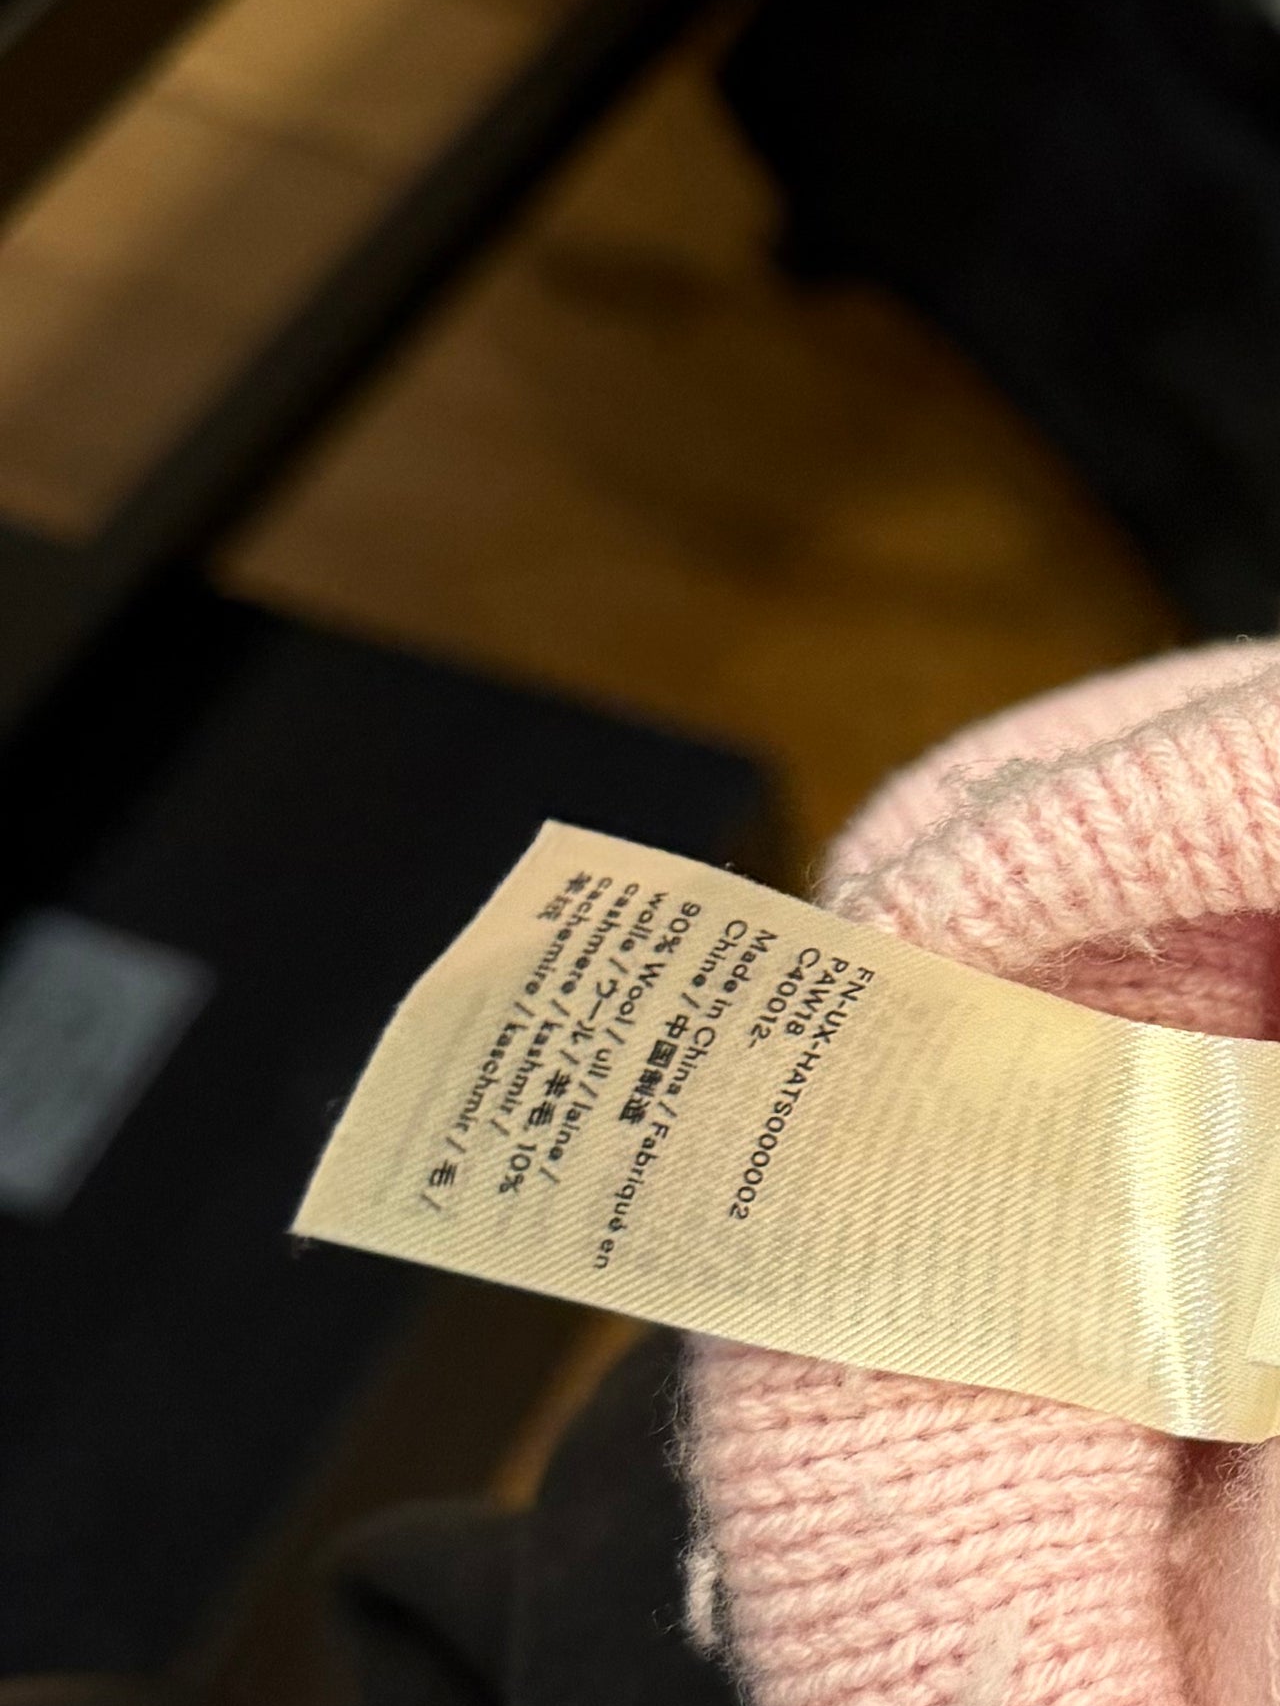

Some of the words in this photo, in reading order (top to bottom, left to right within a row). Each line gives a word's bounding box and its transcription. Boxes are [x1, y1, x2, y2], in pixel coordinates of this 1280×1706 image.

[523, 877, 612, 996] cachemire
[559, 883, 639, 995] cashmere
[619, 892, 666, 952] wolle
[653, 901, 701, 954] 90%
[691, 919, 747, 987] Chine
[722, 929, 777, 993] Made
[570, 978, 618, 1044] ウール
[614, 962, 666, 1025] Wool
[705, 998, 732, 1019] in
[748, 947, 820, 1048] C40012-
[785, 957, 849, 1035] PAW18
[498, 1019, 563, 1114] kashmir
[587, 1048, 611, 1078] ull
[665, 1026, 715, 1095] China
[728, 966, 874, 1220] FN-UX-HATS000002
[547, 1101, 592, 1161] laine
[428, 1160, 456, 1186] 毛
[498, 1143, 536, 1193] 10%
[593, 1238, 614, 1269] en
